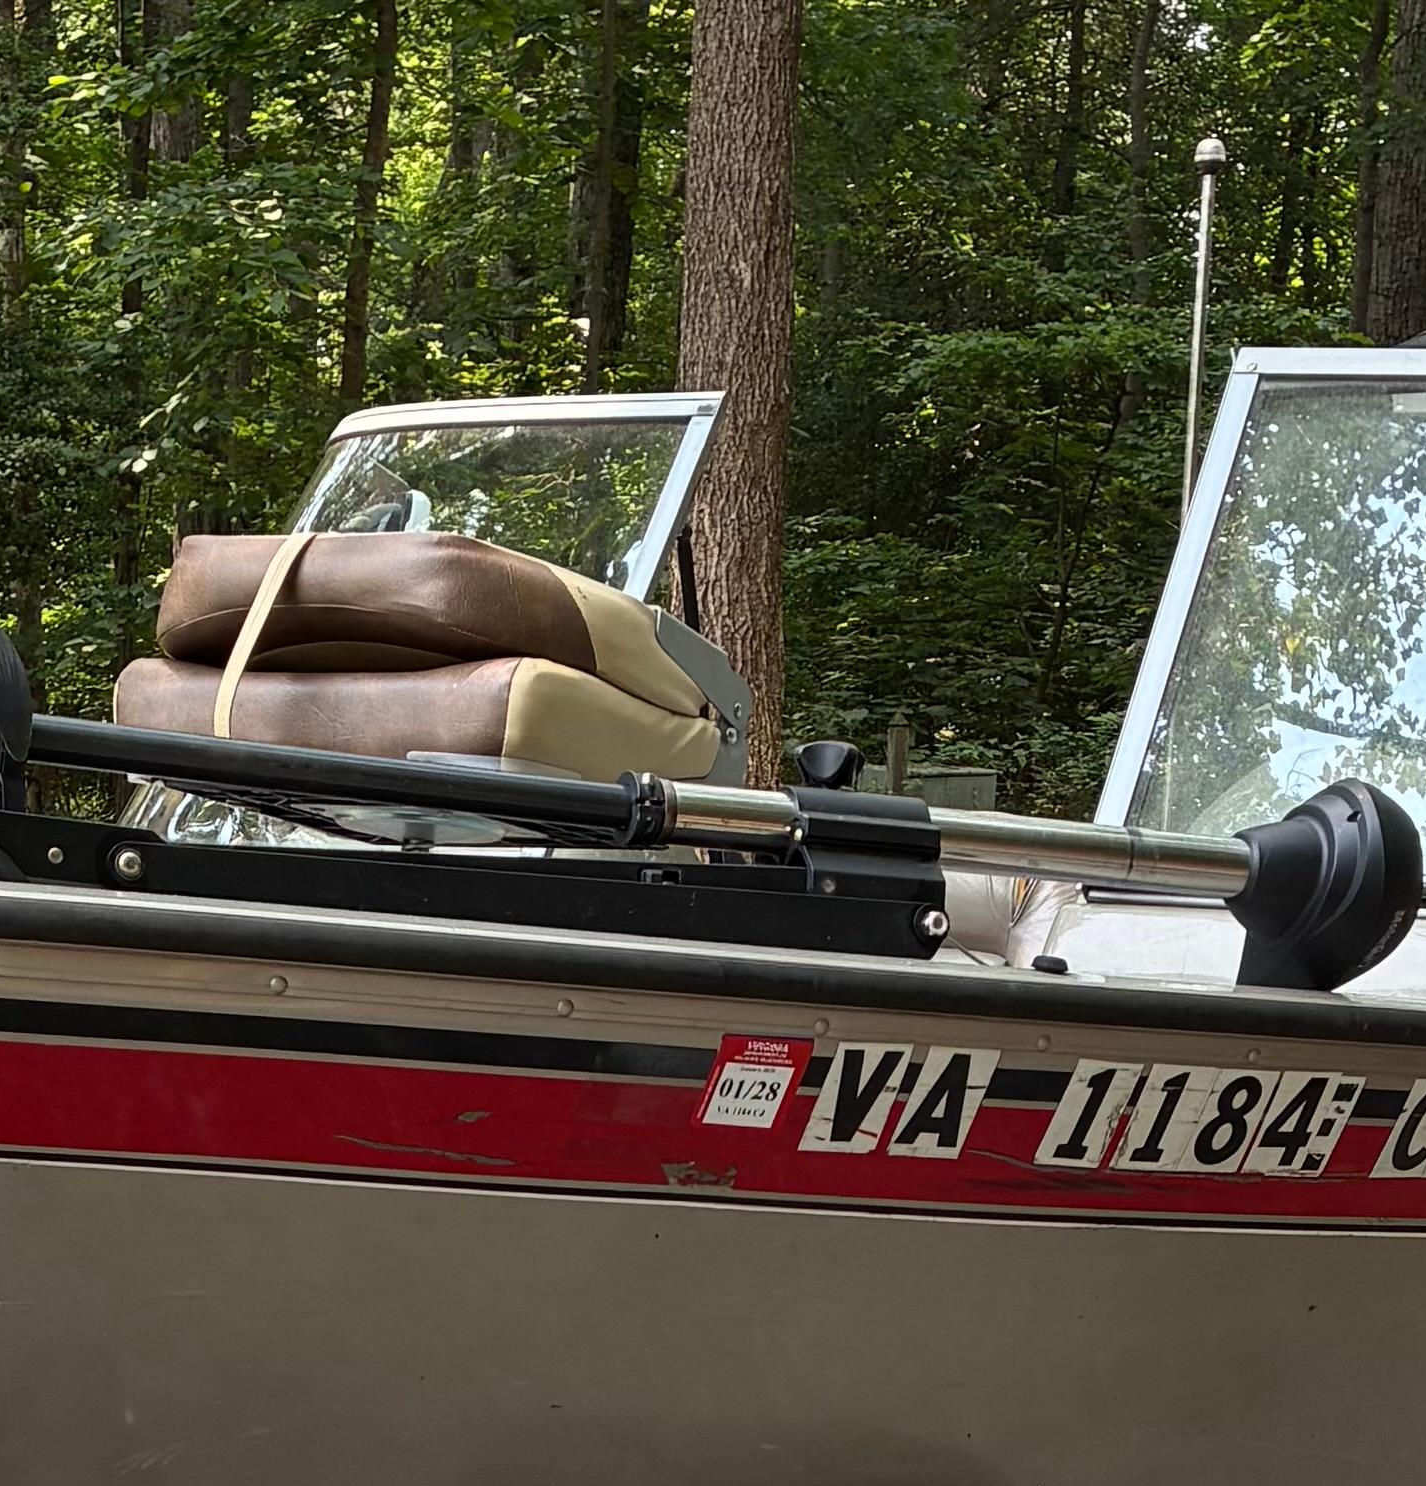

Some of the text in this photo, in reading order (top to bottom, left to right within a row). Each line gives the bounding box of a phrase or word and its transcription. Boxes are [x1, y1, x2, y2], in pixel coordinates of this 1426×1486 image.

[719, 1078, 781, 1102] 01/28
[829, 1047, 971, 1149] VA
[1052, 1067, 1332, 1171] 1184
